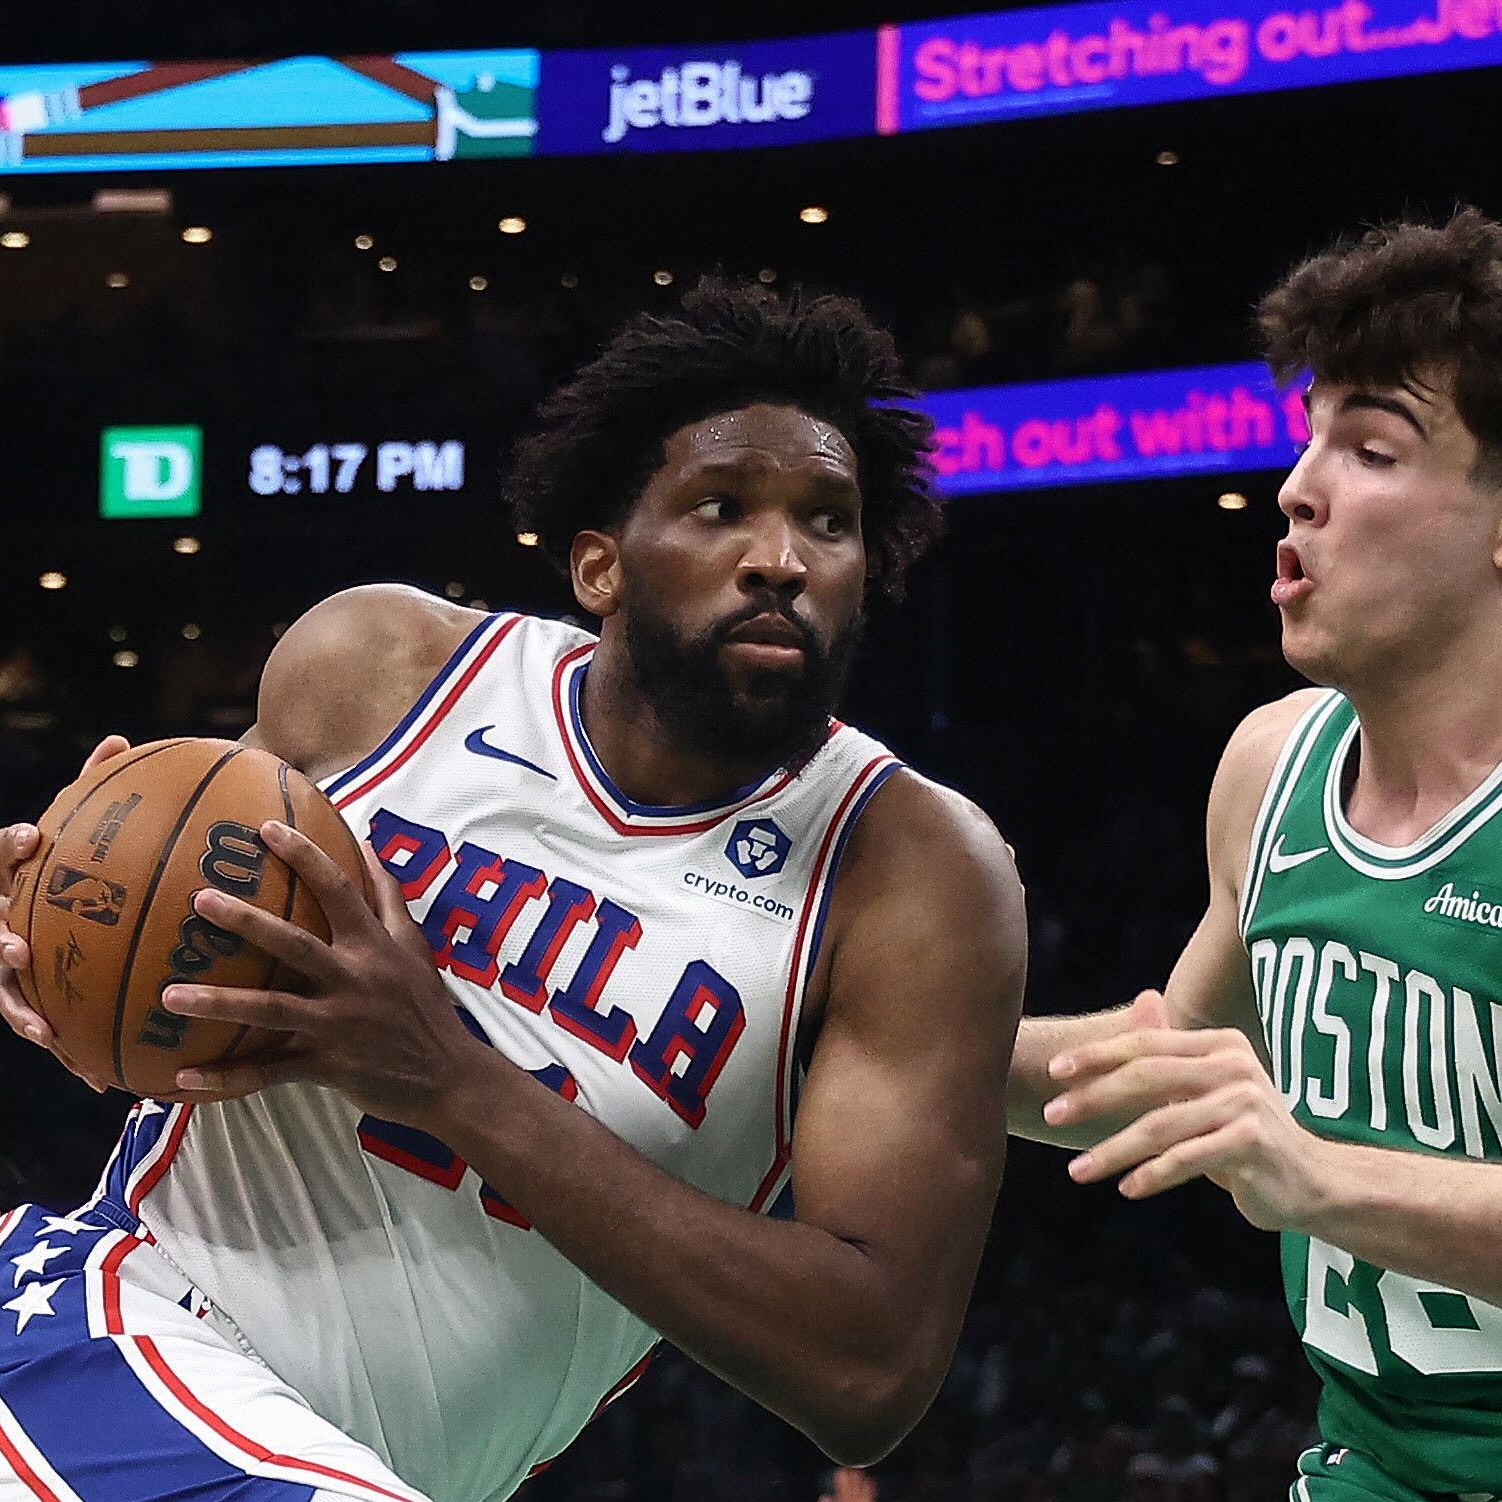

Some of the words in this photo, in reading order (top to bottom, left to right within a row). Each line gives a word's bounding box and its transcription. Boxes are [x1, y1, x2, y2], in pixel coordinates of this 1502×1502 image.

[913, 20, 1250, 103] Stretching
[604, 61, 811, 142] jetBlue
[1011, 404, 1124, 469] out
[1130, 387, 1275, 458] with
[112, 442, 194, 499] TD
[248, 443, 368, 495] 8:17
[376, 441, 465, 492] PM
[683, 871, 794, 921] crypto.com
